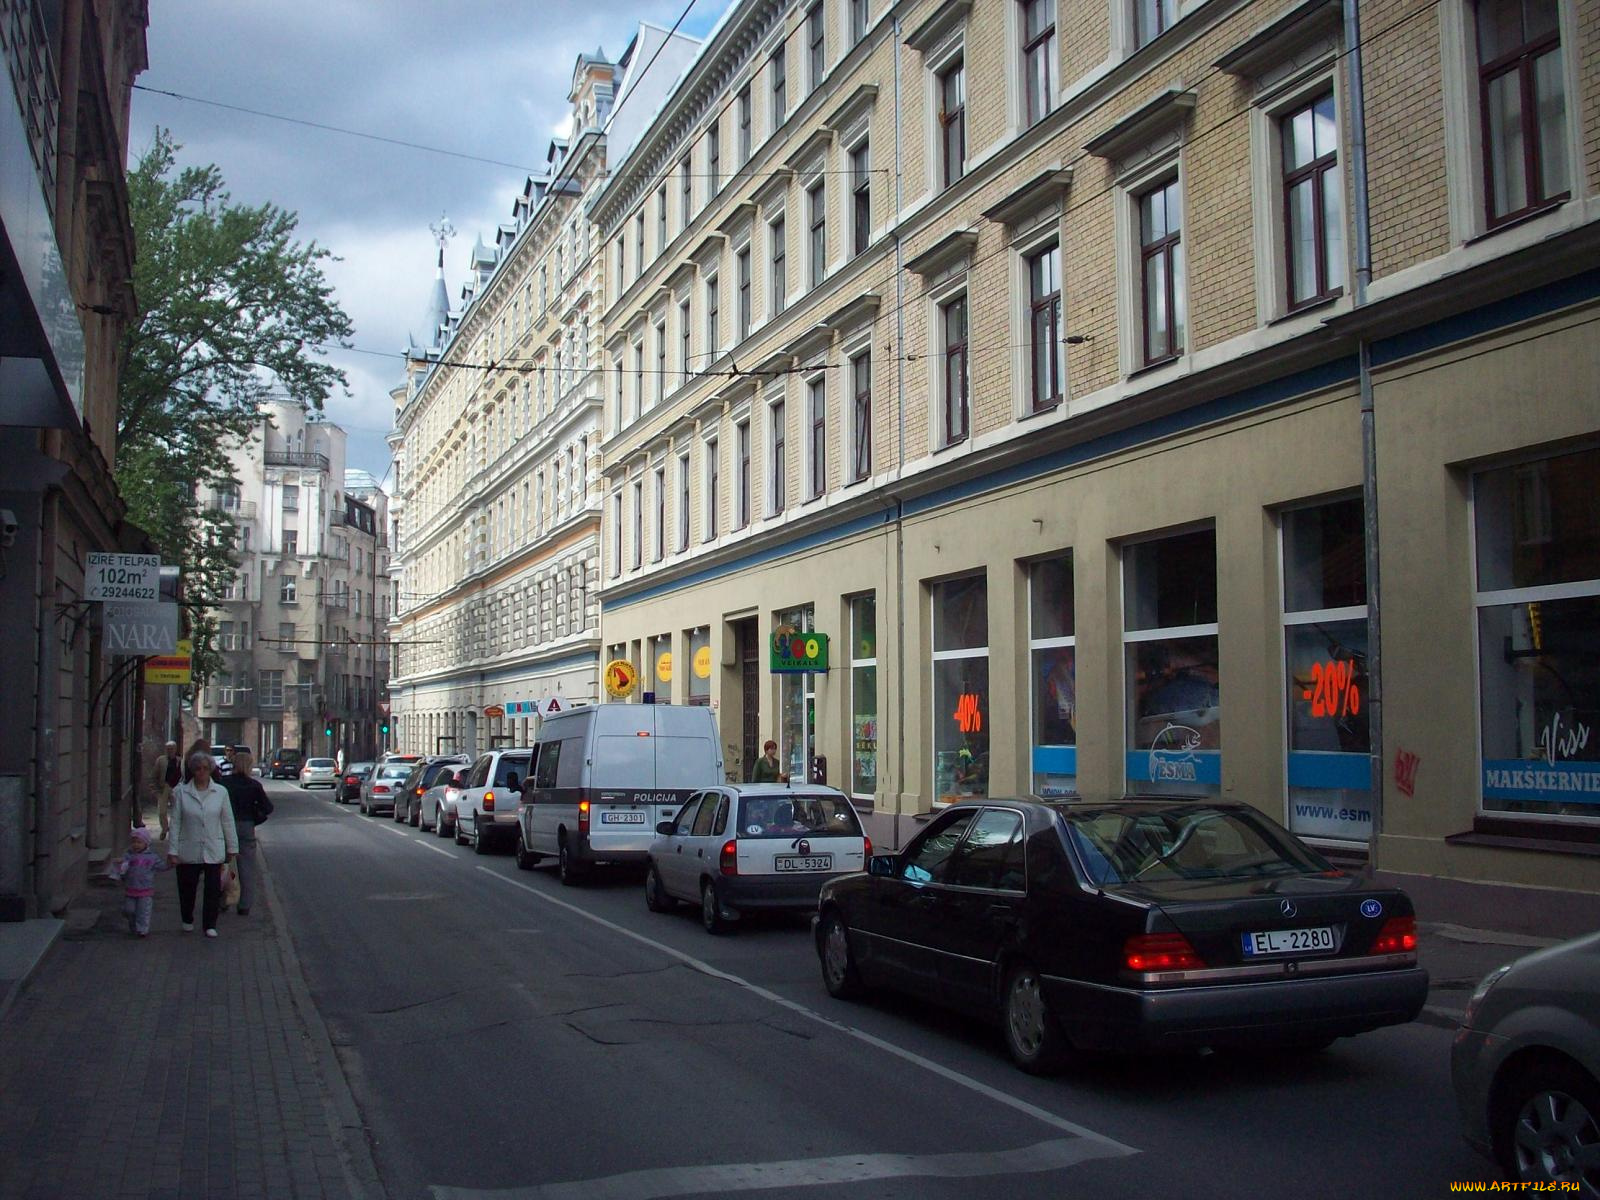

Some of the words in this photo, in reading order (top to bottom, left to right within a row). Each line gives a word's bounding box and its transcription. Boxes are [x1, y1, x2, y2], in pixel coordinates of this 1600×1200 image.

[118, 555, 157, 567] TELPAS
[102, 586, 155, 599] 29244622
[107, 623, 175, 650] NARA
[1304, 658, 1359, 717] -20%
[954, 694, 980, 731] -40%
[1541, 712, 1590, 768] Viss
[633, 793, 677, 802] POLICIJA
[608, 813, 643, 822] GH-2301
[1296, 804, 1371, 822] www.esm
[784, 858, 829, 869] DL-5324
[1366, 904, 1376, 913] LV
[1255, 930, 1330, 952] EL-2280
